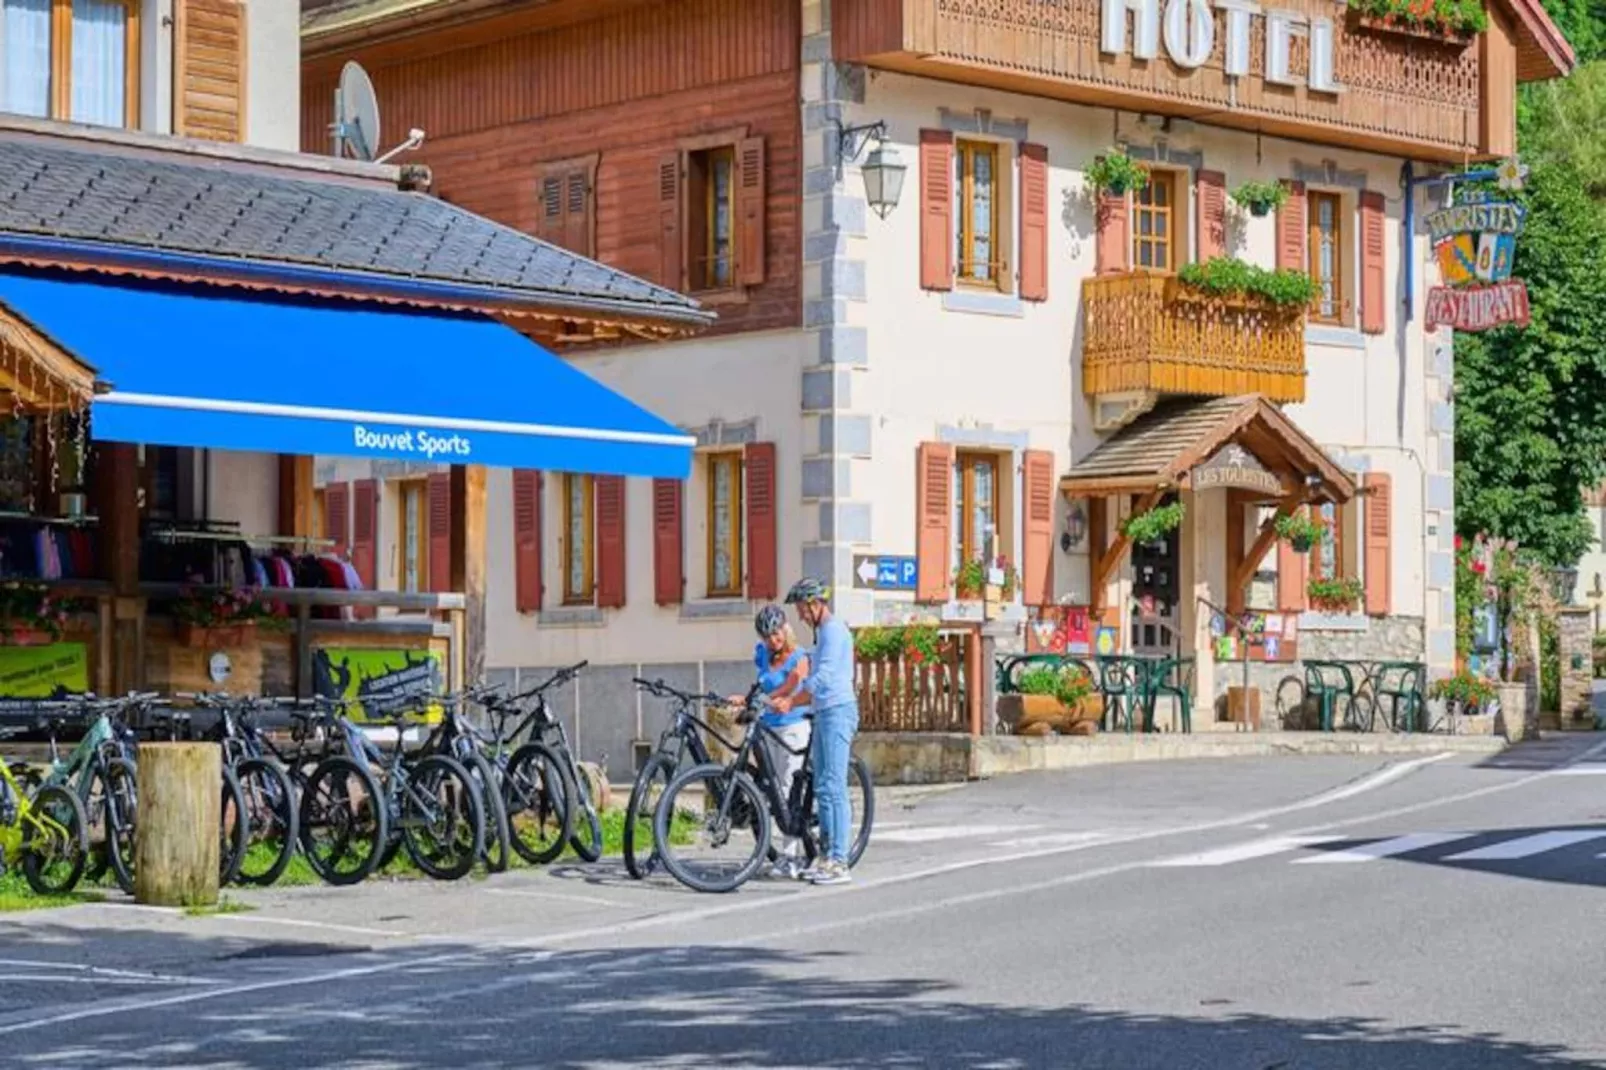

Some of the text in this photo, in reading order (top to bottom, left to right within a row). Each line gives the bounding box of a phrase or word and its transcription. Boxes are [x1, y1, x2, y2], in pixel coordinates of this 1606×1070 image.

[1100, 0, 1347, 92] HOTEL
[1426, 284, 1523, 327] RESTAURANT
[354, 424, 471, 459] Bouvet Sports
[903, 562, 915, 582] P
